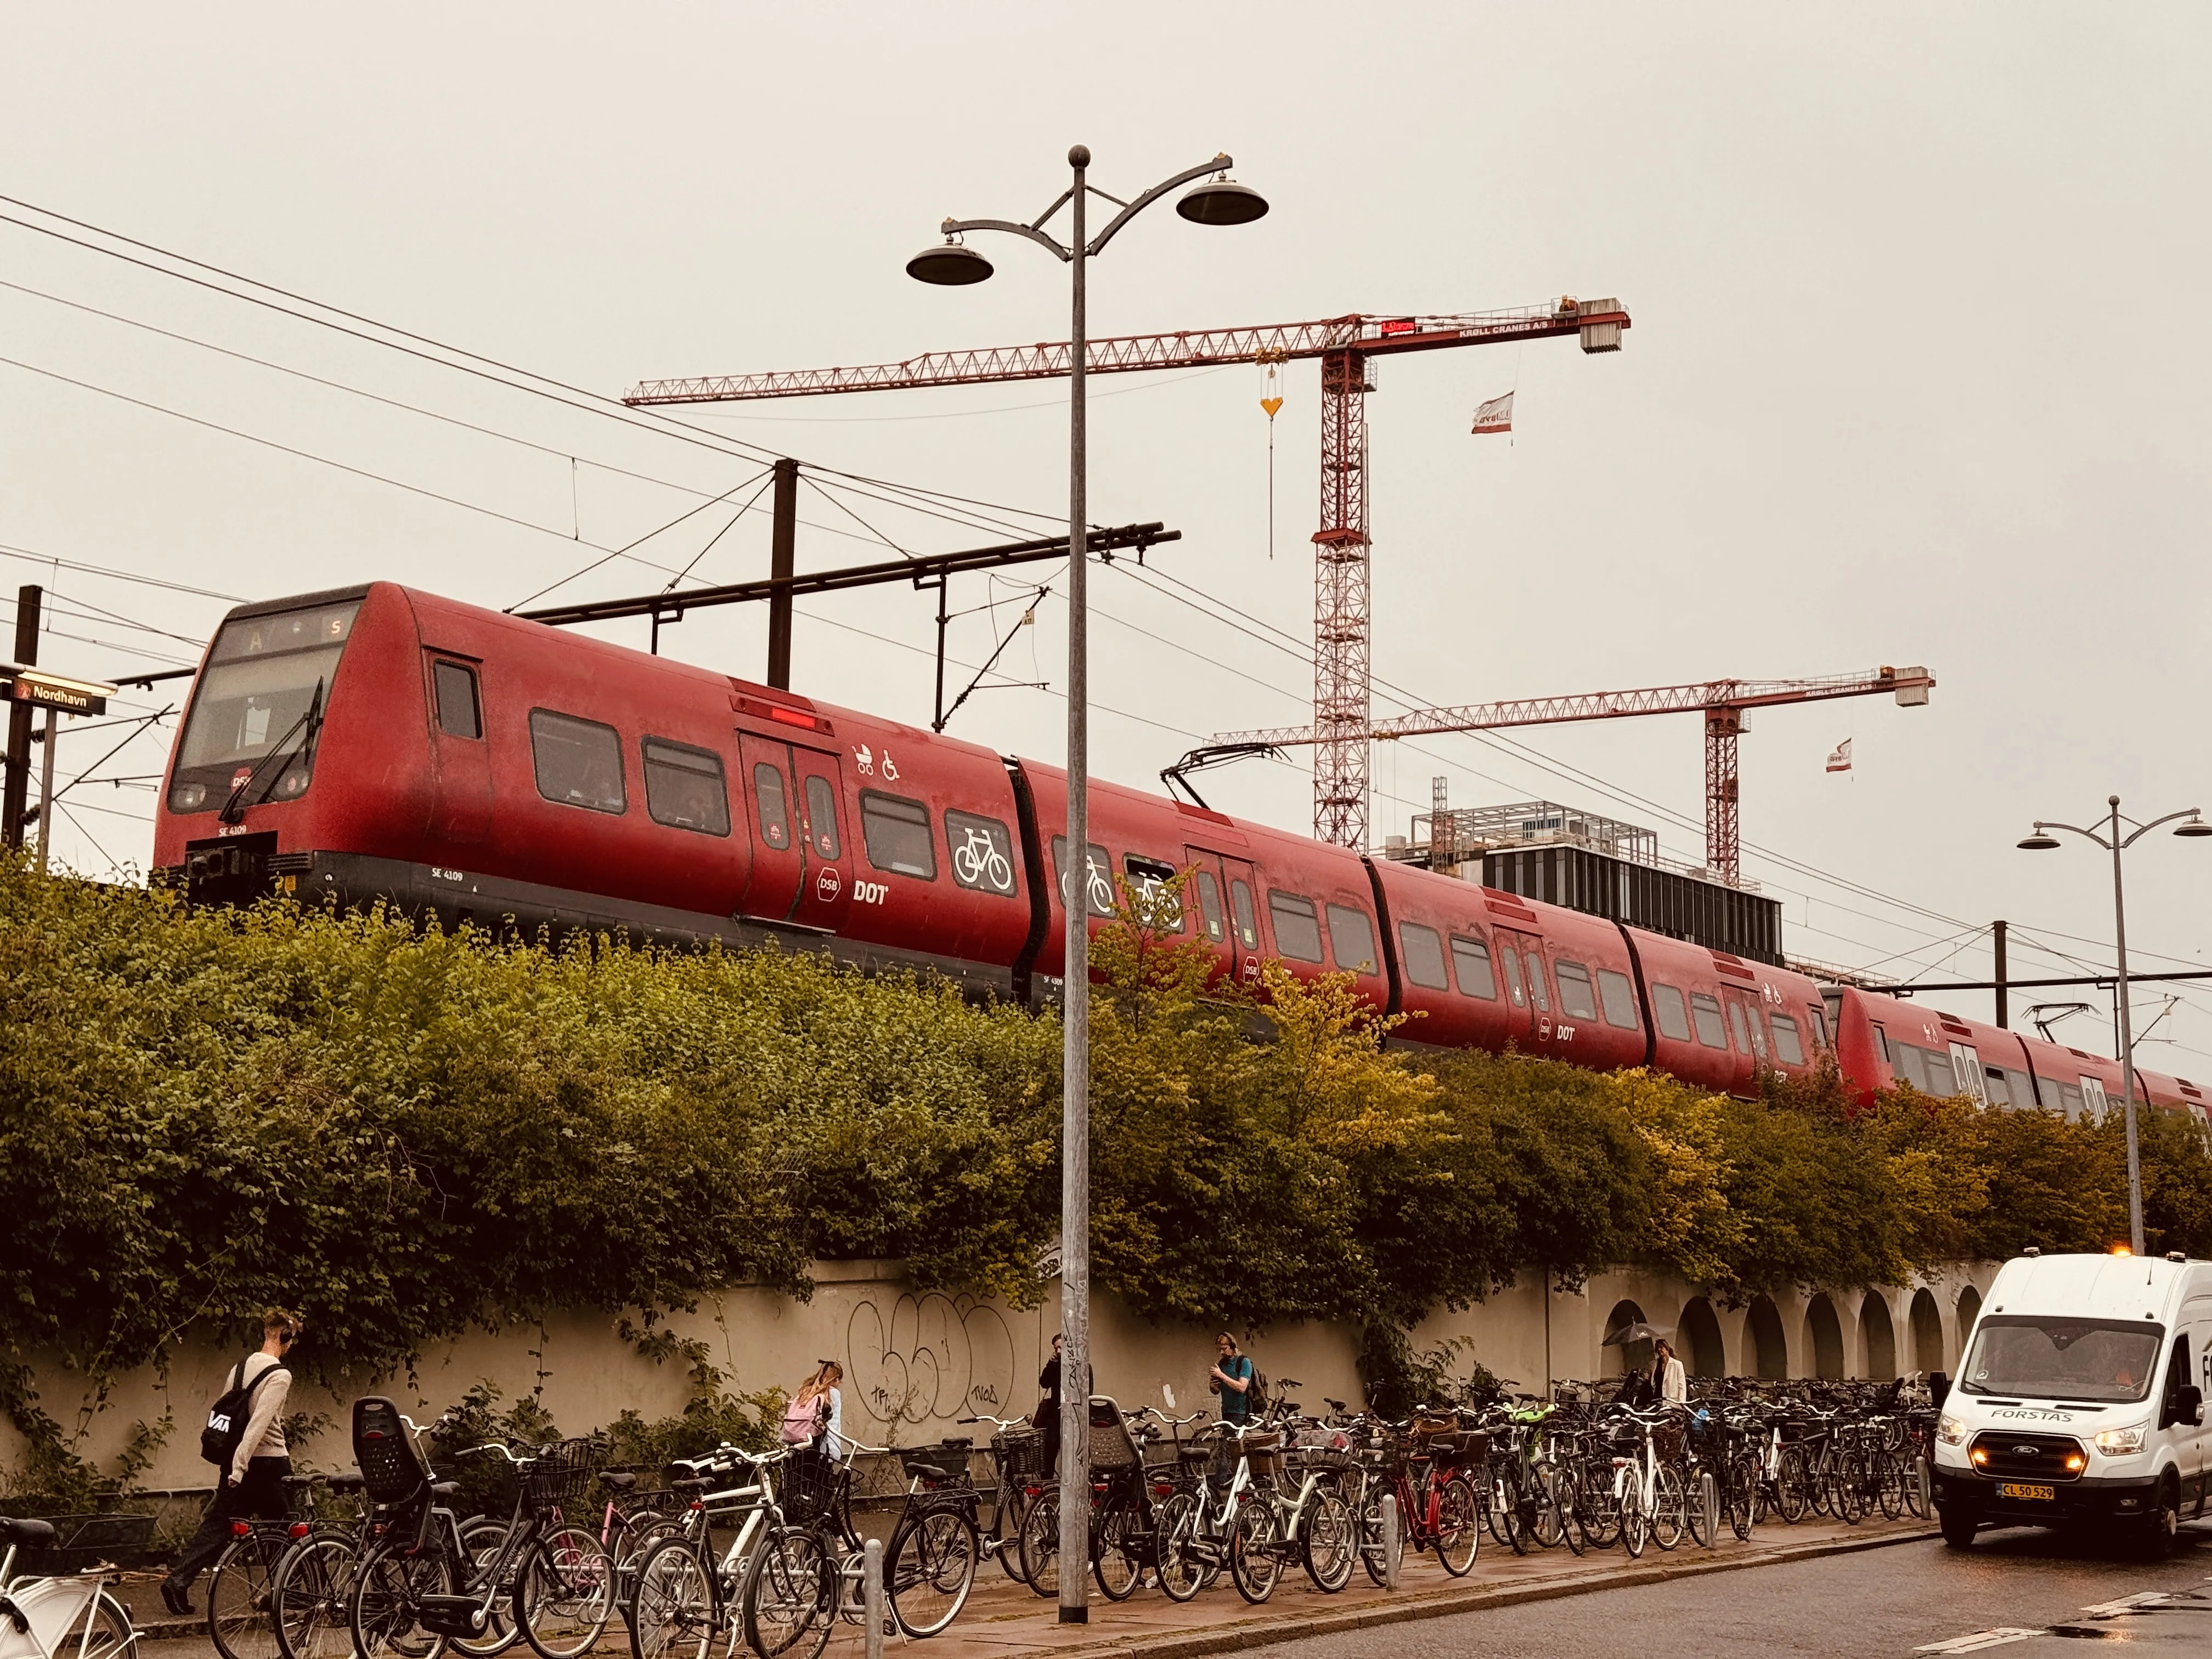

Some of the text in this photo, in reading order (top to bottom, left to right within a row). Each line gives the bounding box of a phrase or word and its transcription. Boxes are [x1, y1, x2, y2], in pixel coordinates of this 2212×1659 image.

[1459, 321, 1548, 338] KRØLL CRANES A/S
[331, 620, 341, 634] S
[33, 685, 87, 707] Nordhavn
[219, 825, 247, 838] SE 4109
[432, 867, 463, 882] SE 4109
[820, 878, 838, 891] DSB
[1245, 965, 1257, 975] DSB
[1991, 1410, 2074, 1423] FORSTAS
[2004, 1485, 2053, 1498] CL 50 529
